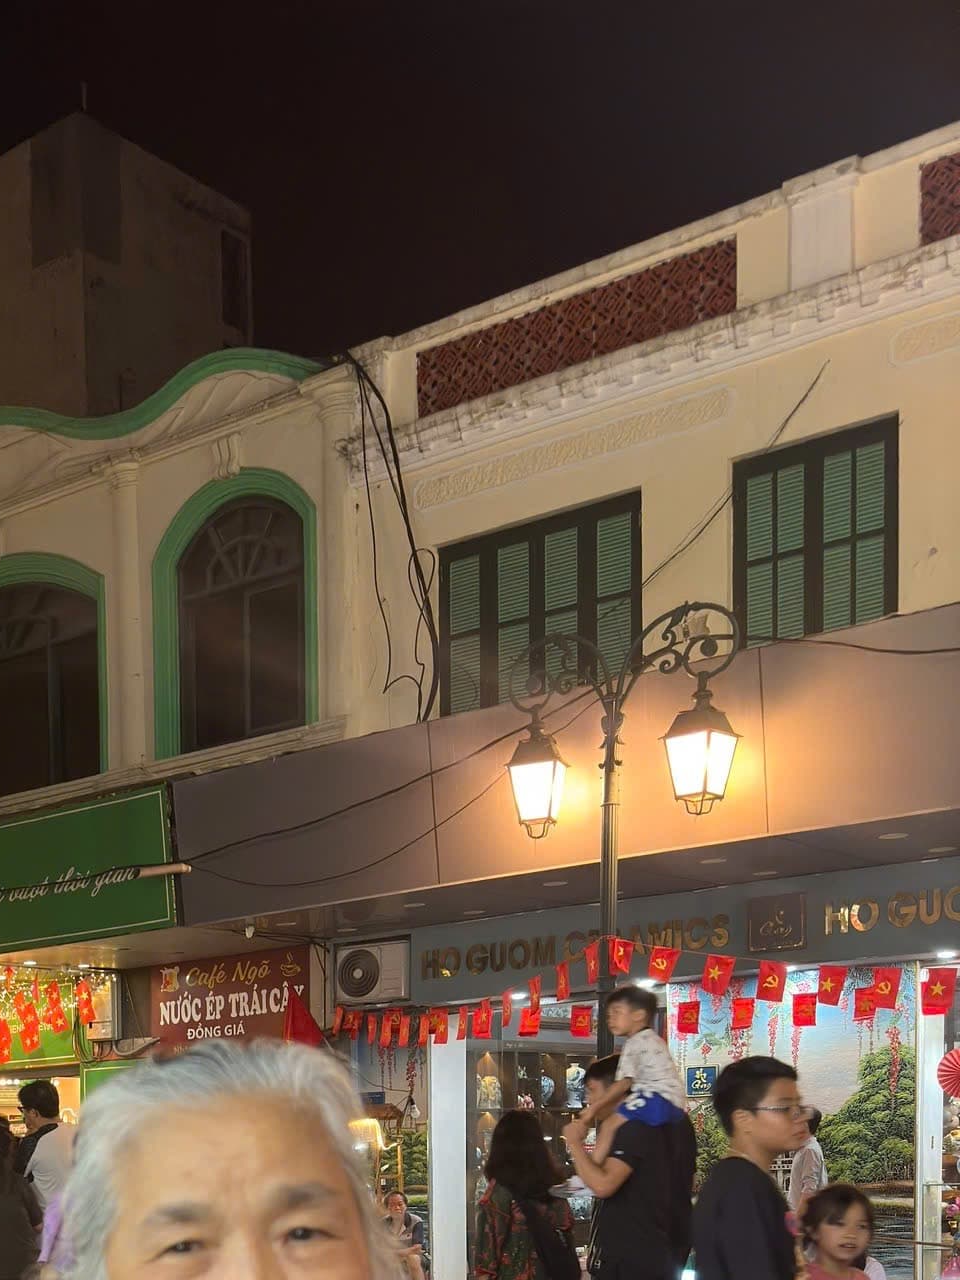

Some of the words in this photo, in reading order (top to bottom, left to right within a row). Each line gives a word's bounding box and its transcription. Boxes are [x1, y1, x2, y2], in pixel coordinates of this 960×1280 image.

[91, 865, 136, 897] gian
[824, 898, 880, 936] HO
[420, 949, 461, 981] HO
[464, 935, 556, 976] GUOM
[563, 913, 731, 963] CAMICS
[185, 963, 227, 989] Café
[231, 960, 272, 985] Ngõ
[159, 991, 202, 1026] NƯỚC
[205, 990, 225, 1021] ÉP
[228, 983, 267, 1018] TRÁI
[186, 1022, 222, 1040] ĐỒNG
[224, 1020, 246, 1036] GIÁ
